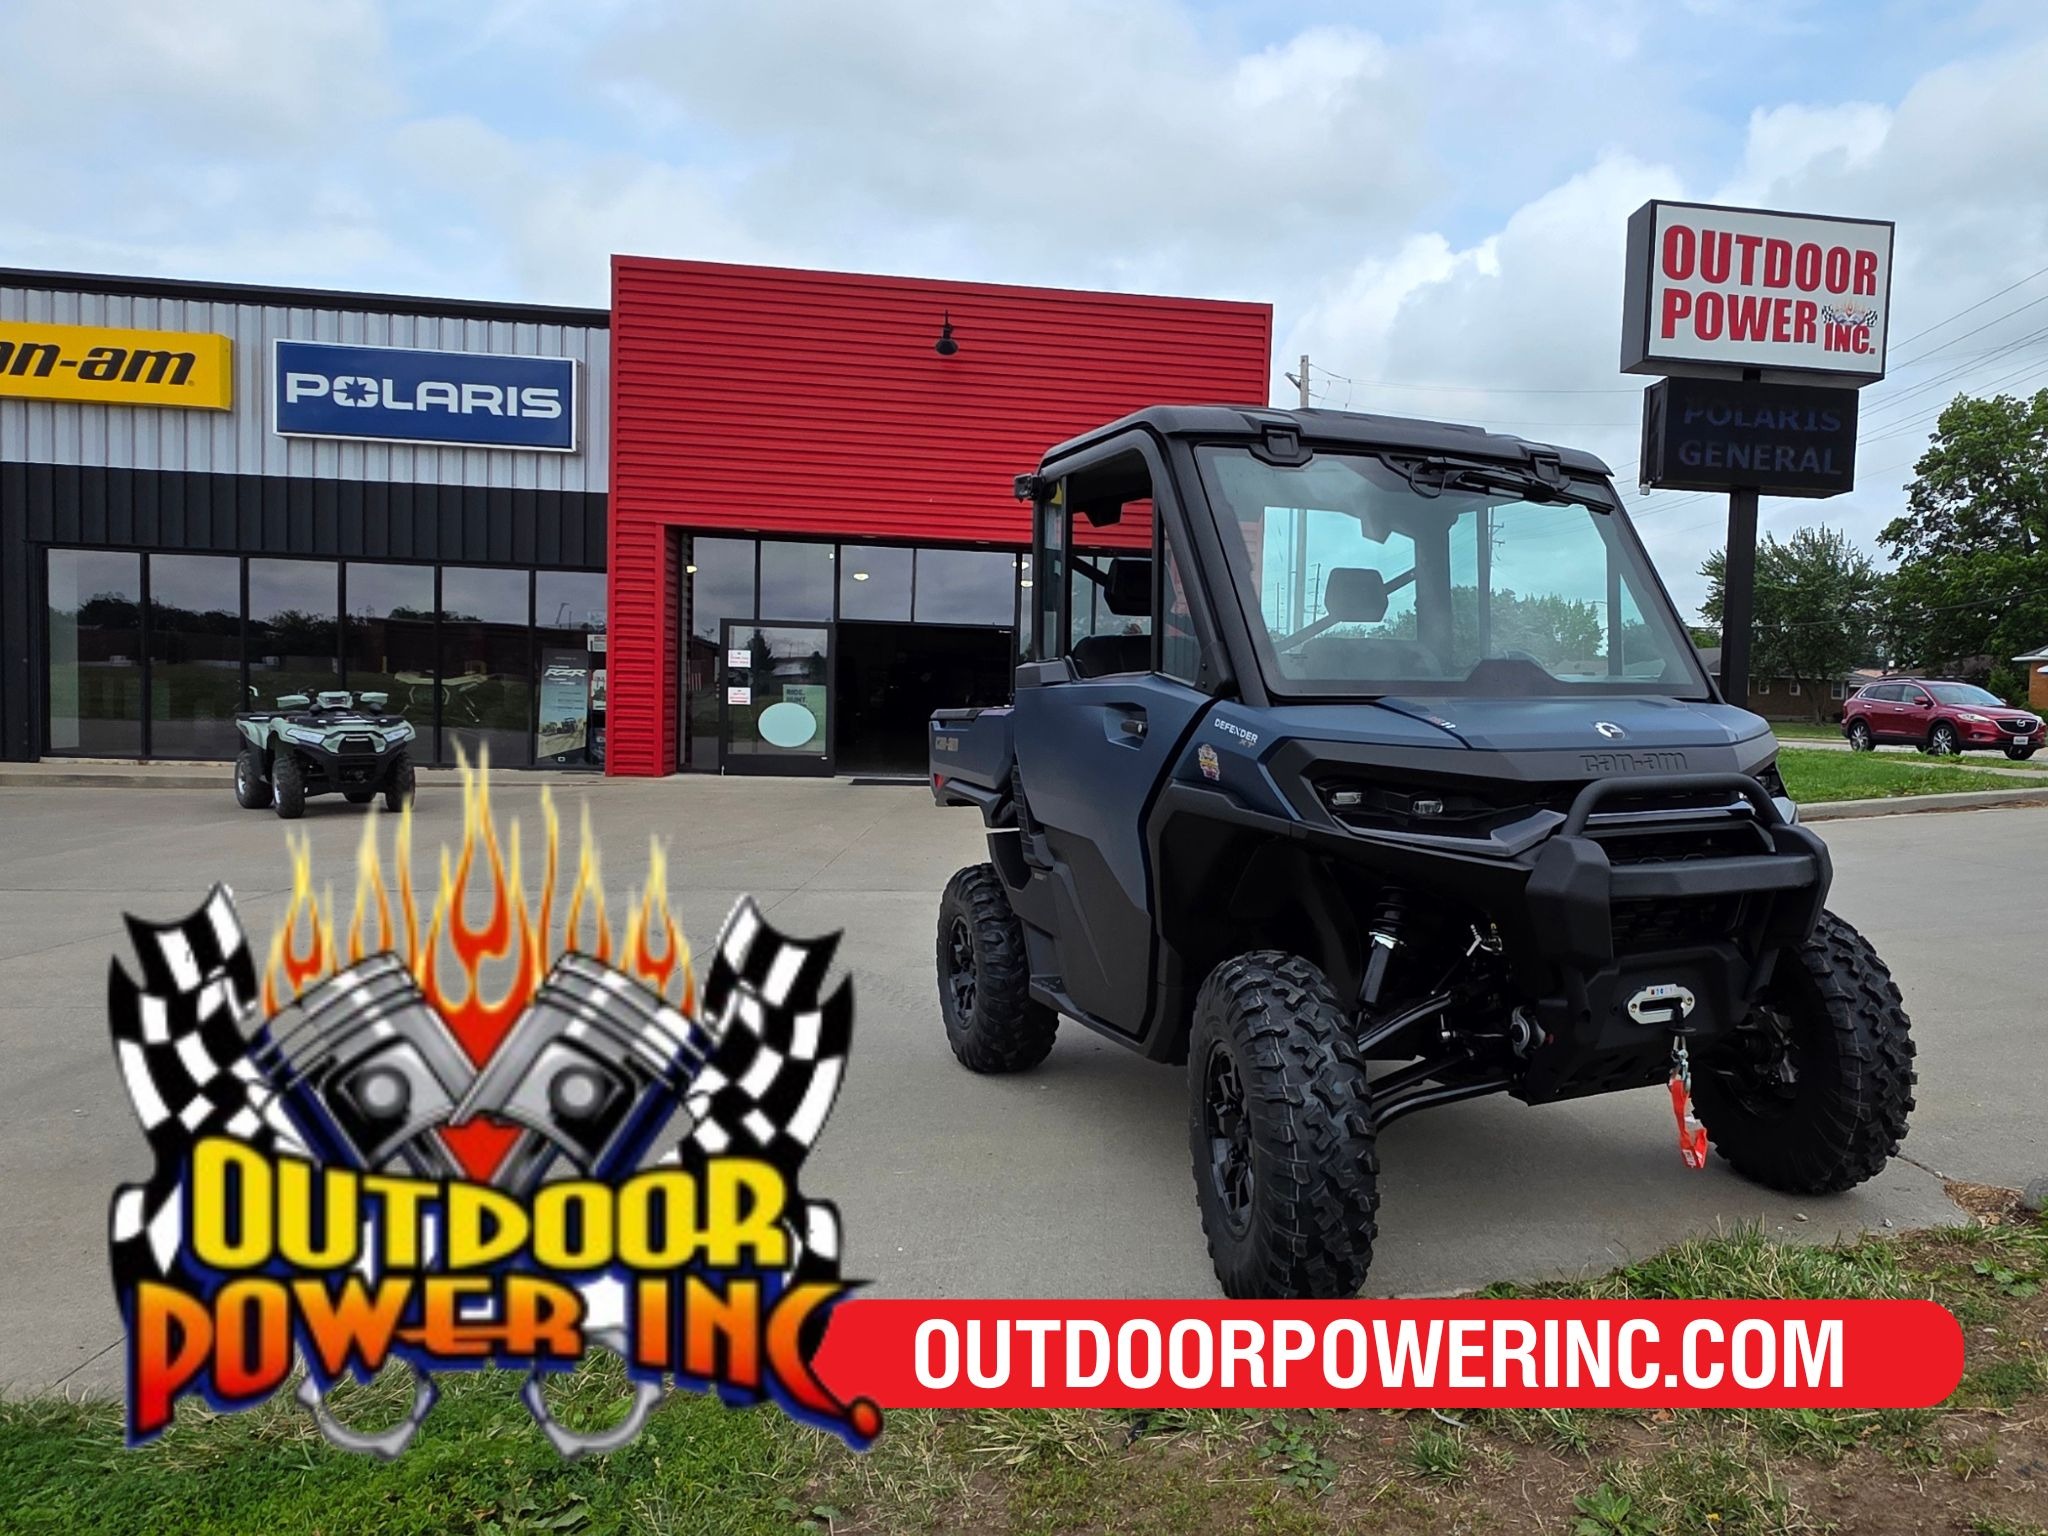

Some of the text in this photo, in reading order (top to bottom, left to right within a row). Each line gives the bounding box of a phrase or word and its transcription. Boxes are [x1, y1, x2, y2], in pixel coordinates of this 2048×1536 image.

[1662, 225, 1878, 296] OUTDOOR
[1661, 287, 1876, 354] POWER INC.
[286, 372, 562, 418] POLARIS
[1683, 396, 1842, 432] POLARIS
[1678, 439, 1843, 475] GENERAL
[1214, 718, 1258, 743] DEFENDER
